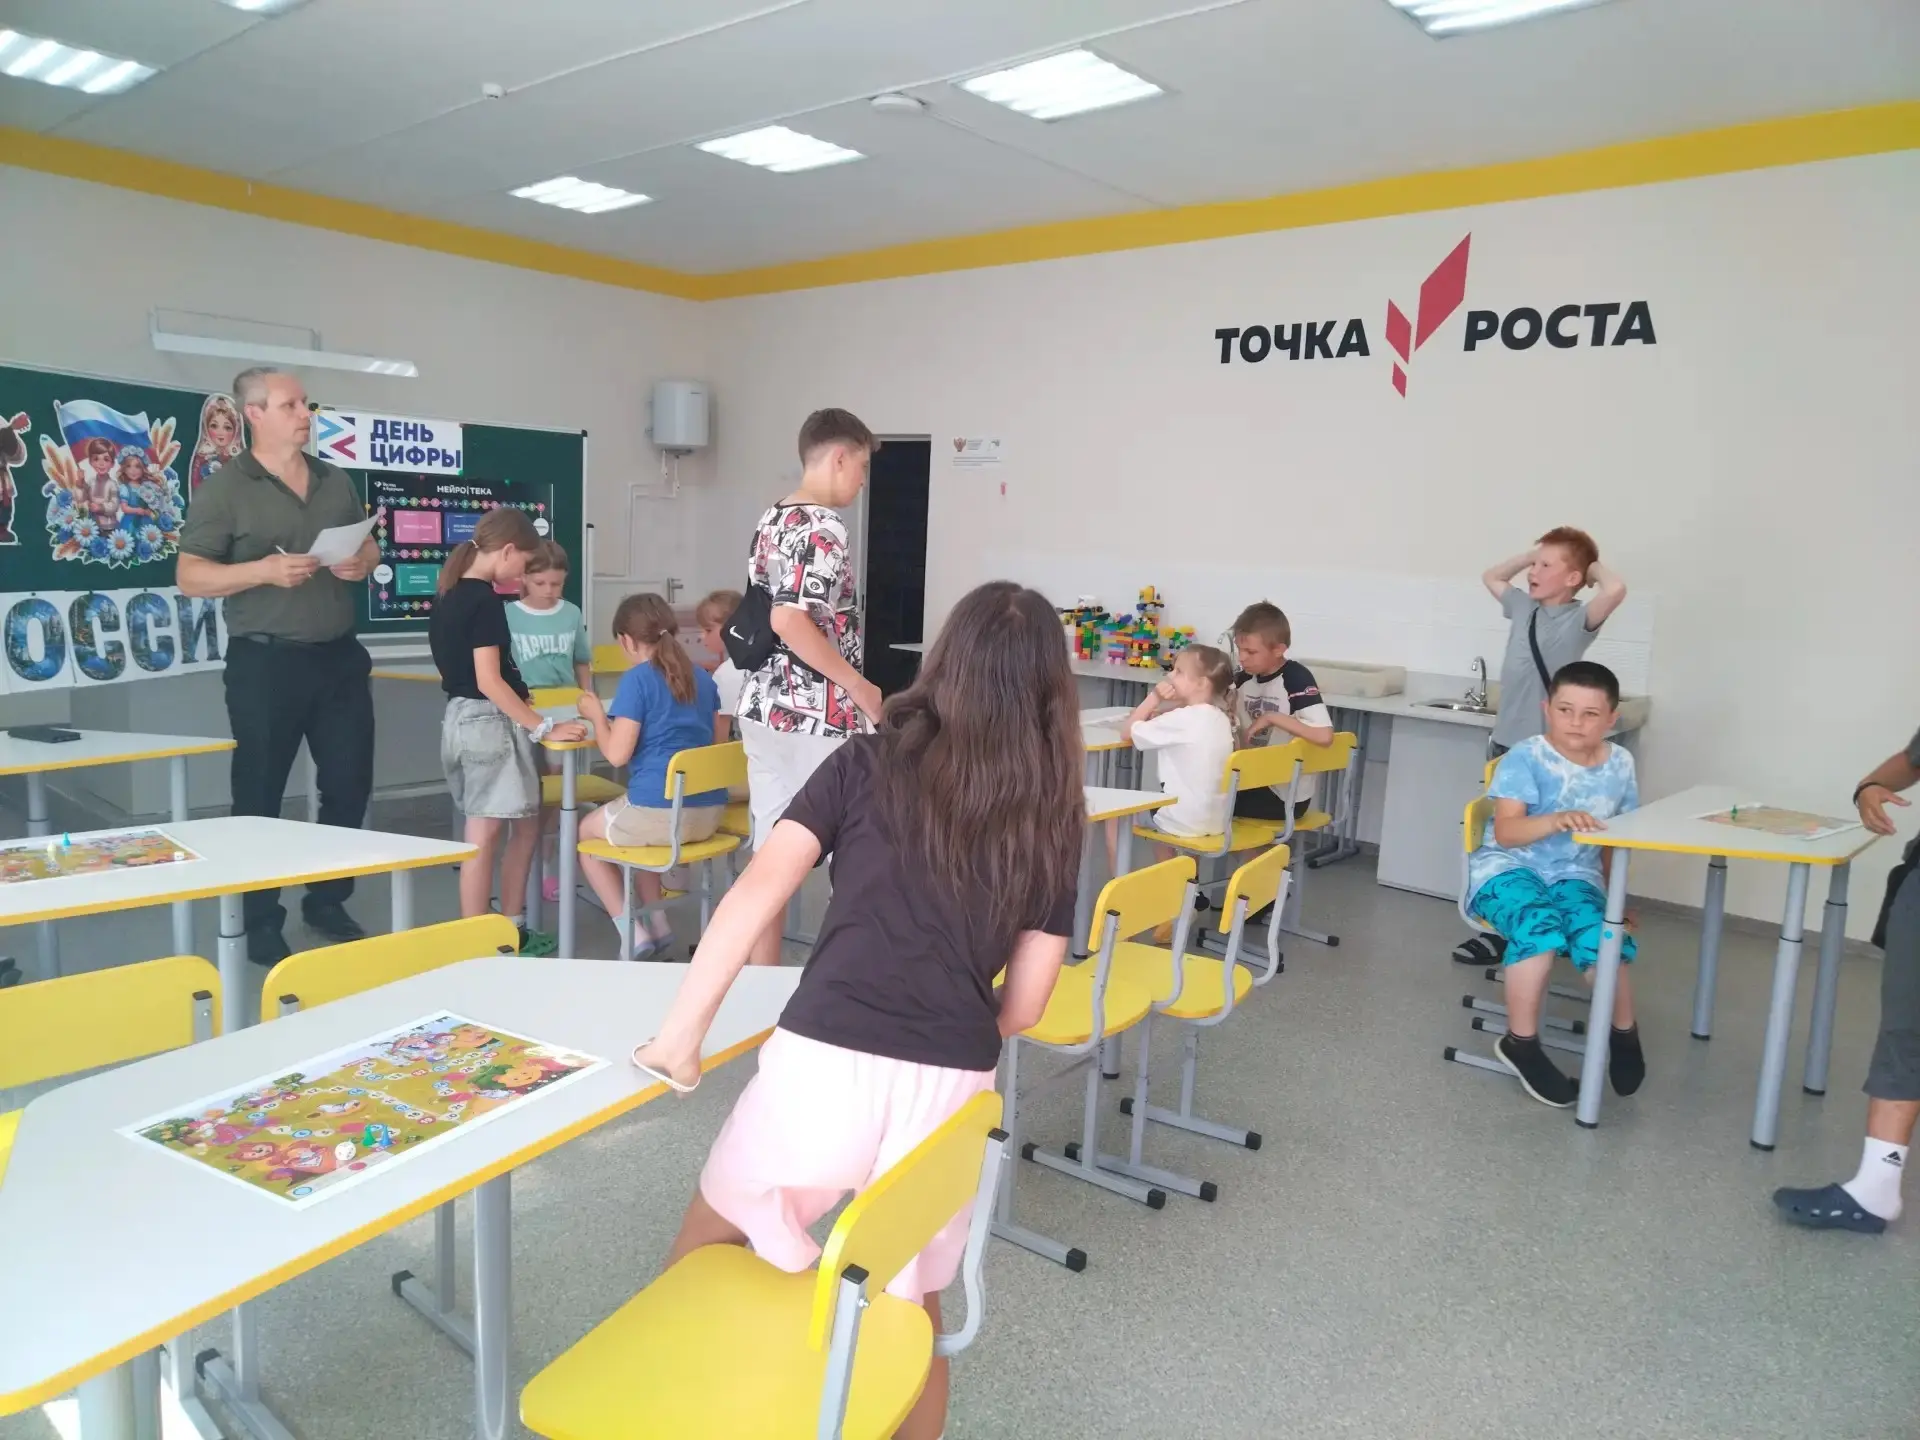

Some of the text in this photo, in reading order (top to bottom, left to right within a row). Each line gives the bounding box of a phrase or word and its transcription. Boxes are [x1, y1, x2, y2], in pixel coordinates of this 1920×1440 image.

[1214, 300, 1657, 364] ТОЧКА РОСТА
[370, 419, 434, 443] ДЕНЬ
[370, 443, 461, 469] ЦИФРЫ
[4, 592, 228, 682] ОССИ
